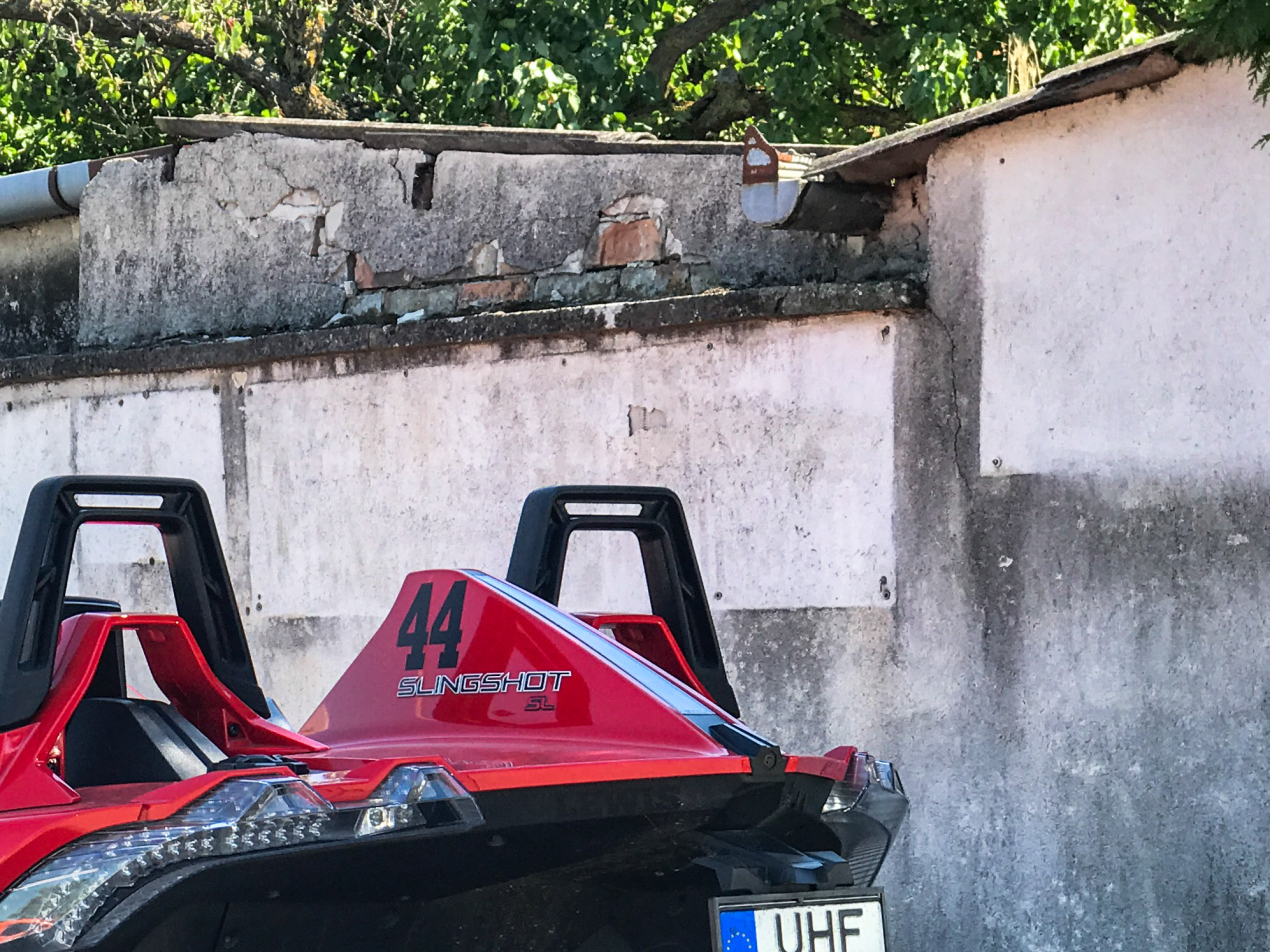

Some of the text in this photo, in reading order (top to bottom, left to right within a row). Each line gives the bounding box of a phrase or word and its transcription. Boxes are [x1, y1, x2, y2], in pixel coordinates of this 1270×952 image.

[397, 580, 468, 670] 44
[397, 671, 571, 697] SLINGSHOT
[524, 695, 555, 711] SL
